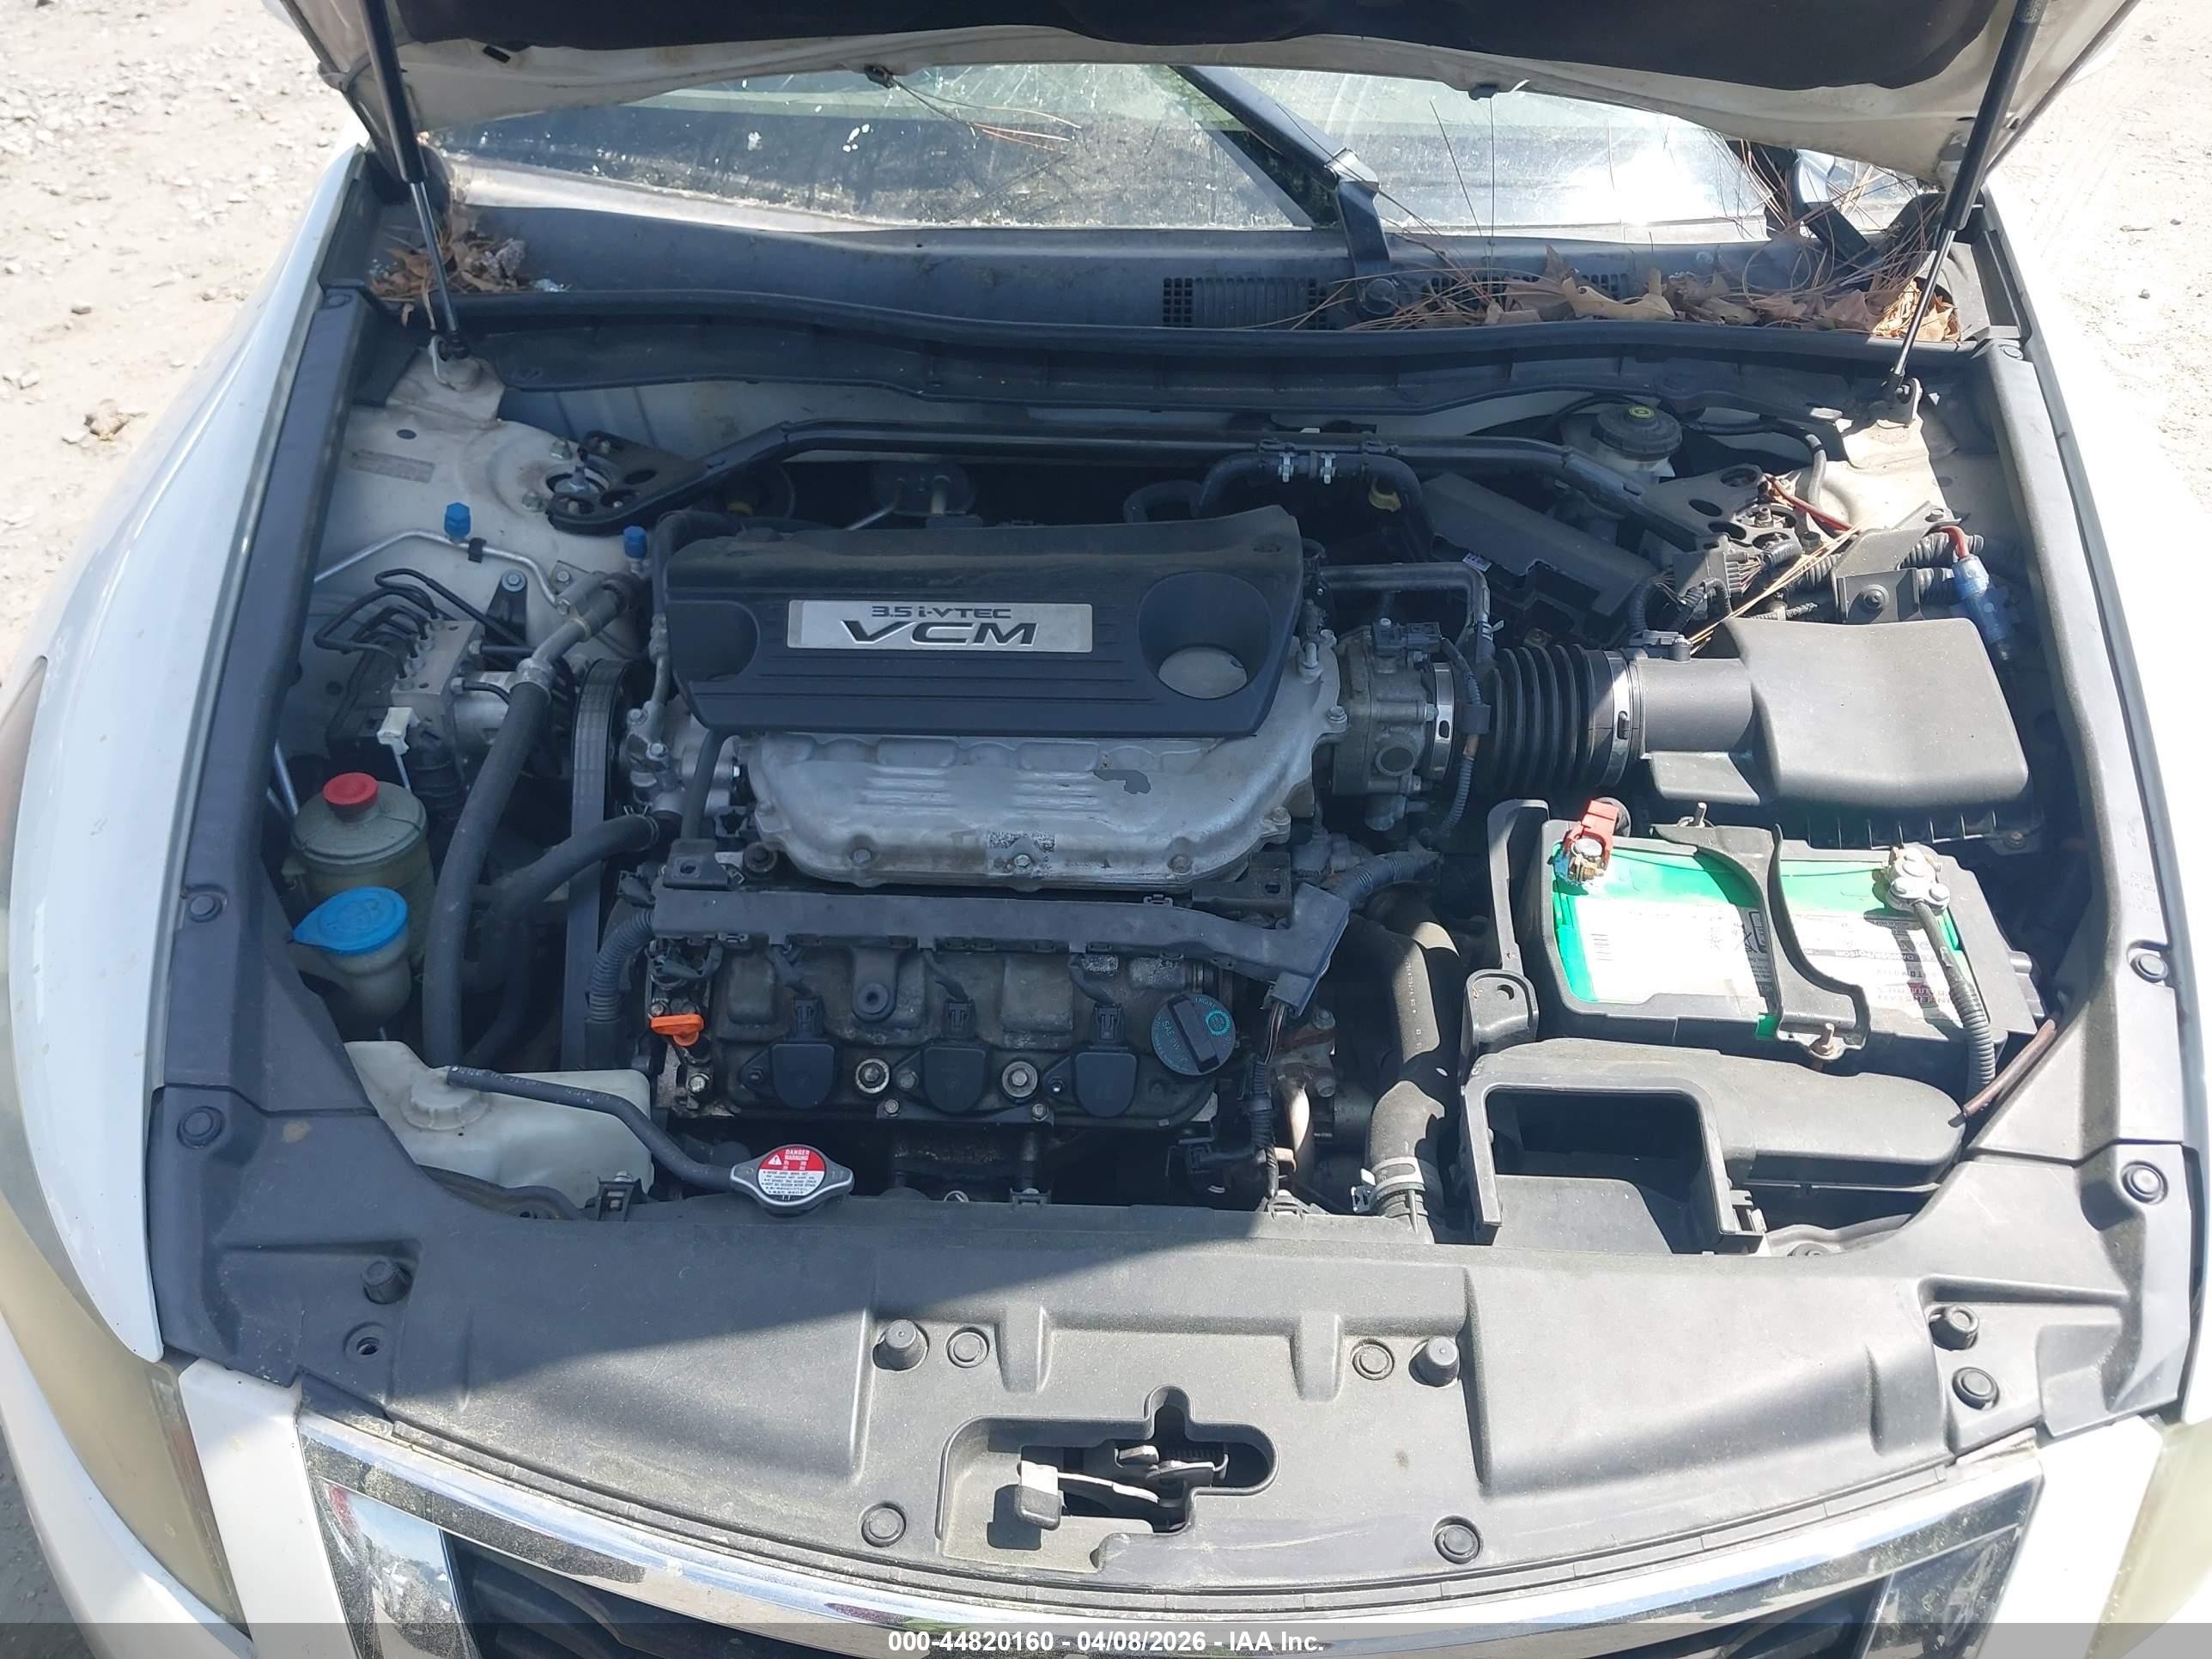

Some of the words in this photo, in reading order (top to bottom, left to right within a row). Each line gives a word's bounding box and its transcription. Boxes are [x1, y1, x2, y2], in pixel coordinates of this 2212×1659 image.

[872, 605, 912, 617] 3.5
[917, 605, 1012, 619] i-VTEC
[840, 619, 1039, 647] VCM
